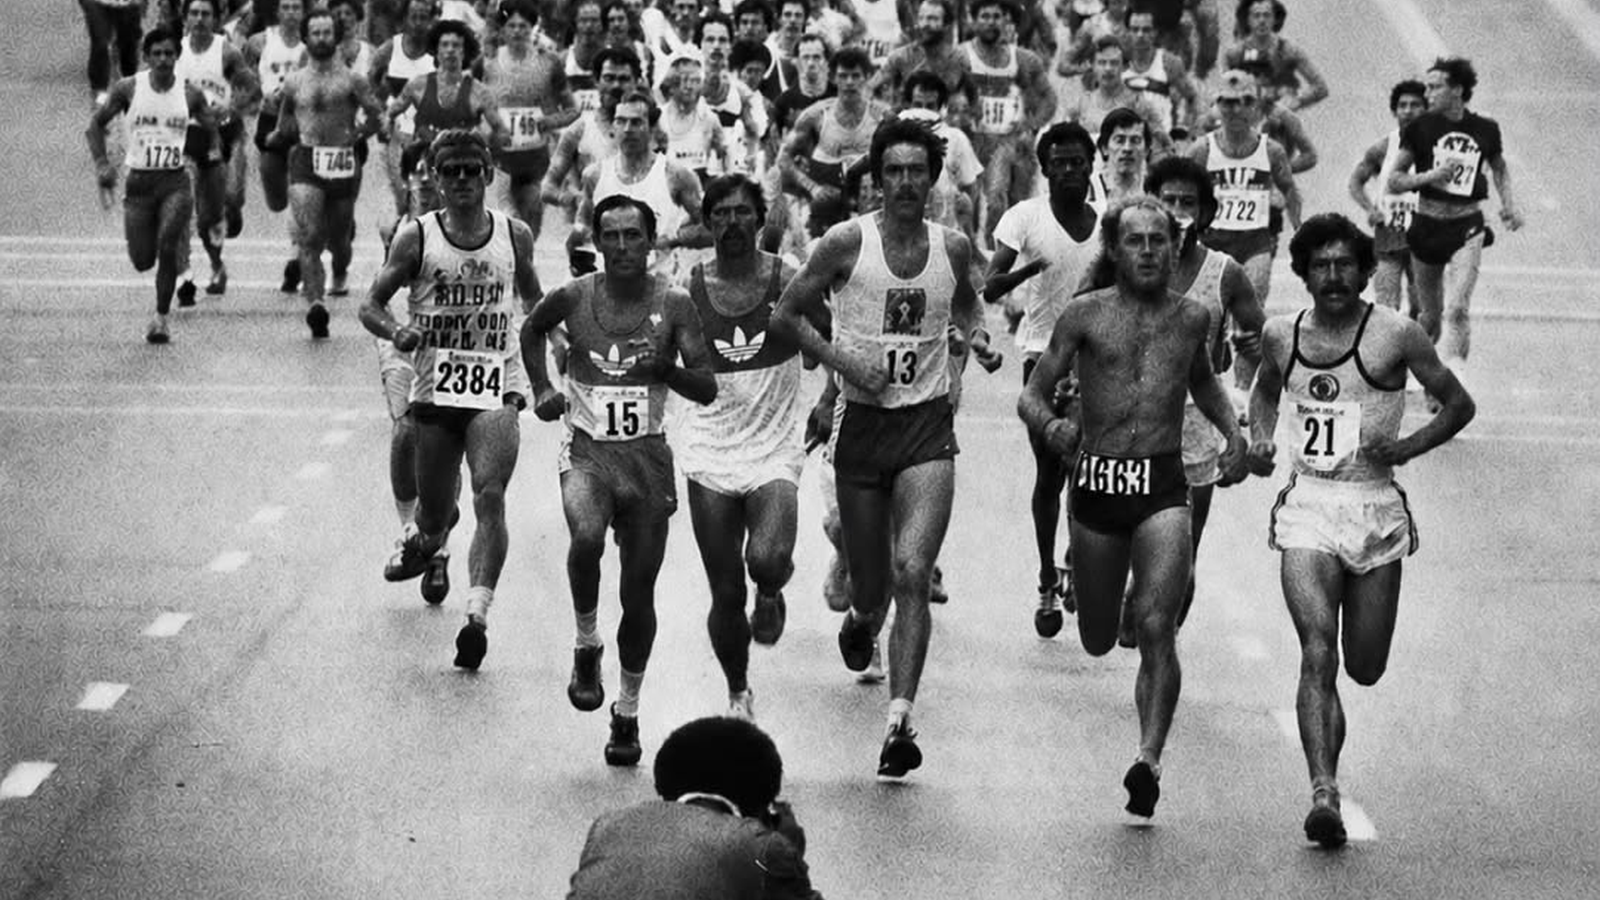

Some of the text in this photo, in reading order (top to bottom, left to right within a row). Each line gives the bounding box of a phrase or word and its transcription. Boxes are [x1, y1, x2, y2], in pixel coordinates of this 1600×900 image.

[146, 145, 181, 168] 1728
[435, 362, 501, 398] 2384
[887, 349, 917, 385] 13
[605, 401, 639, 436] 15
[1303, 416, 1336, 457] 21
[1085, 457, 1147, 496] 1663
